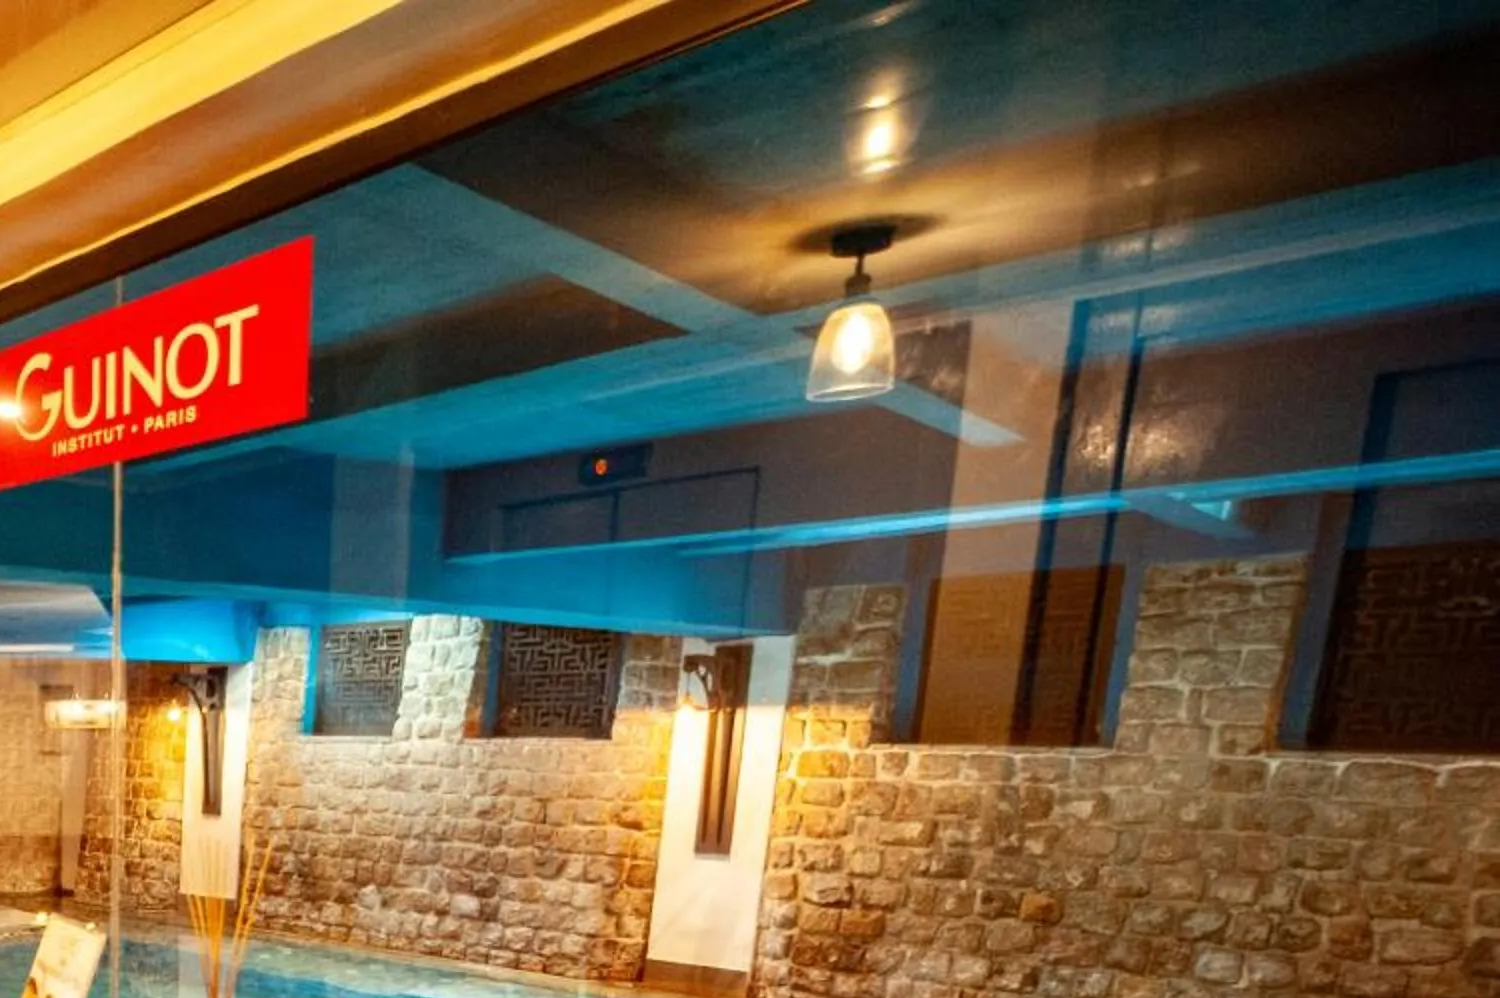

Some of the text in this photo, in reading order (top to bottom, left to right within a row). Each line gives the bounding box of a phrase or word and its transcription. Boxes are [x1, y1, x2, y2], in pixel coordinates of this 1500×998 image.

[15, 303, 260, 442] GUINOT
[52, 405, 197, 457] INSTITUT PARIS
